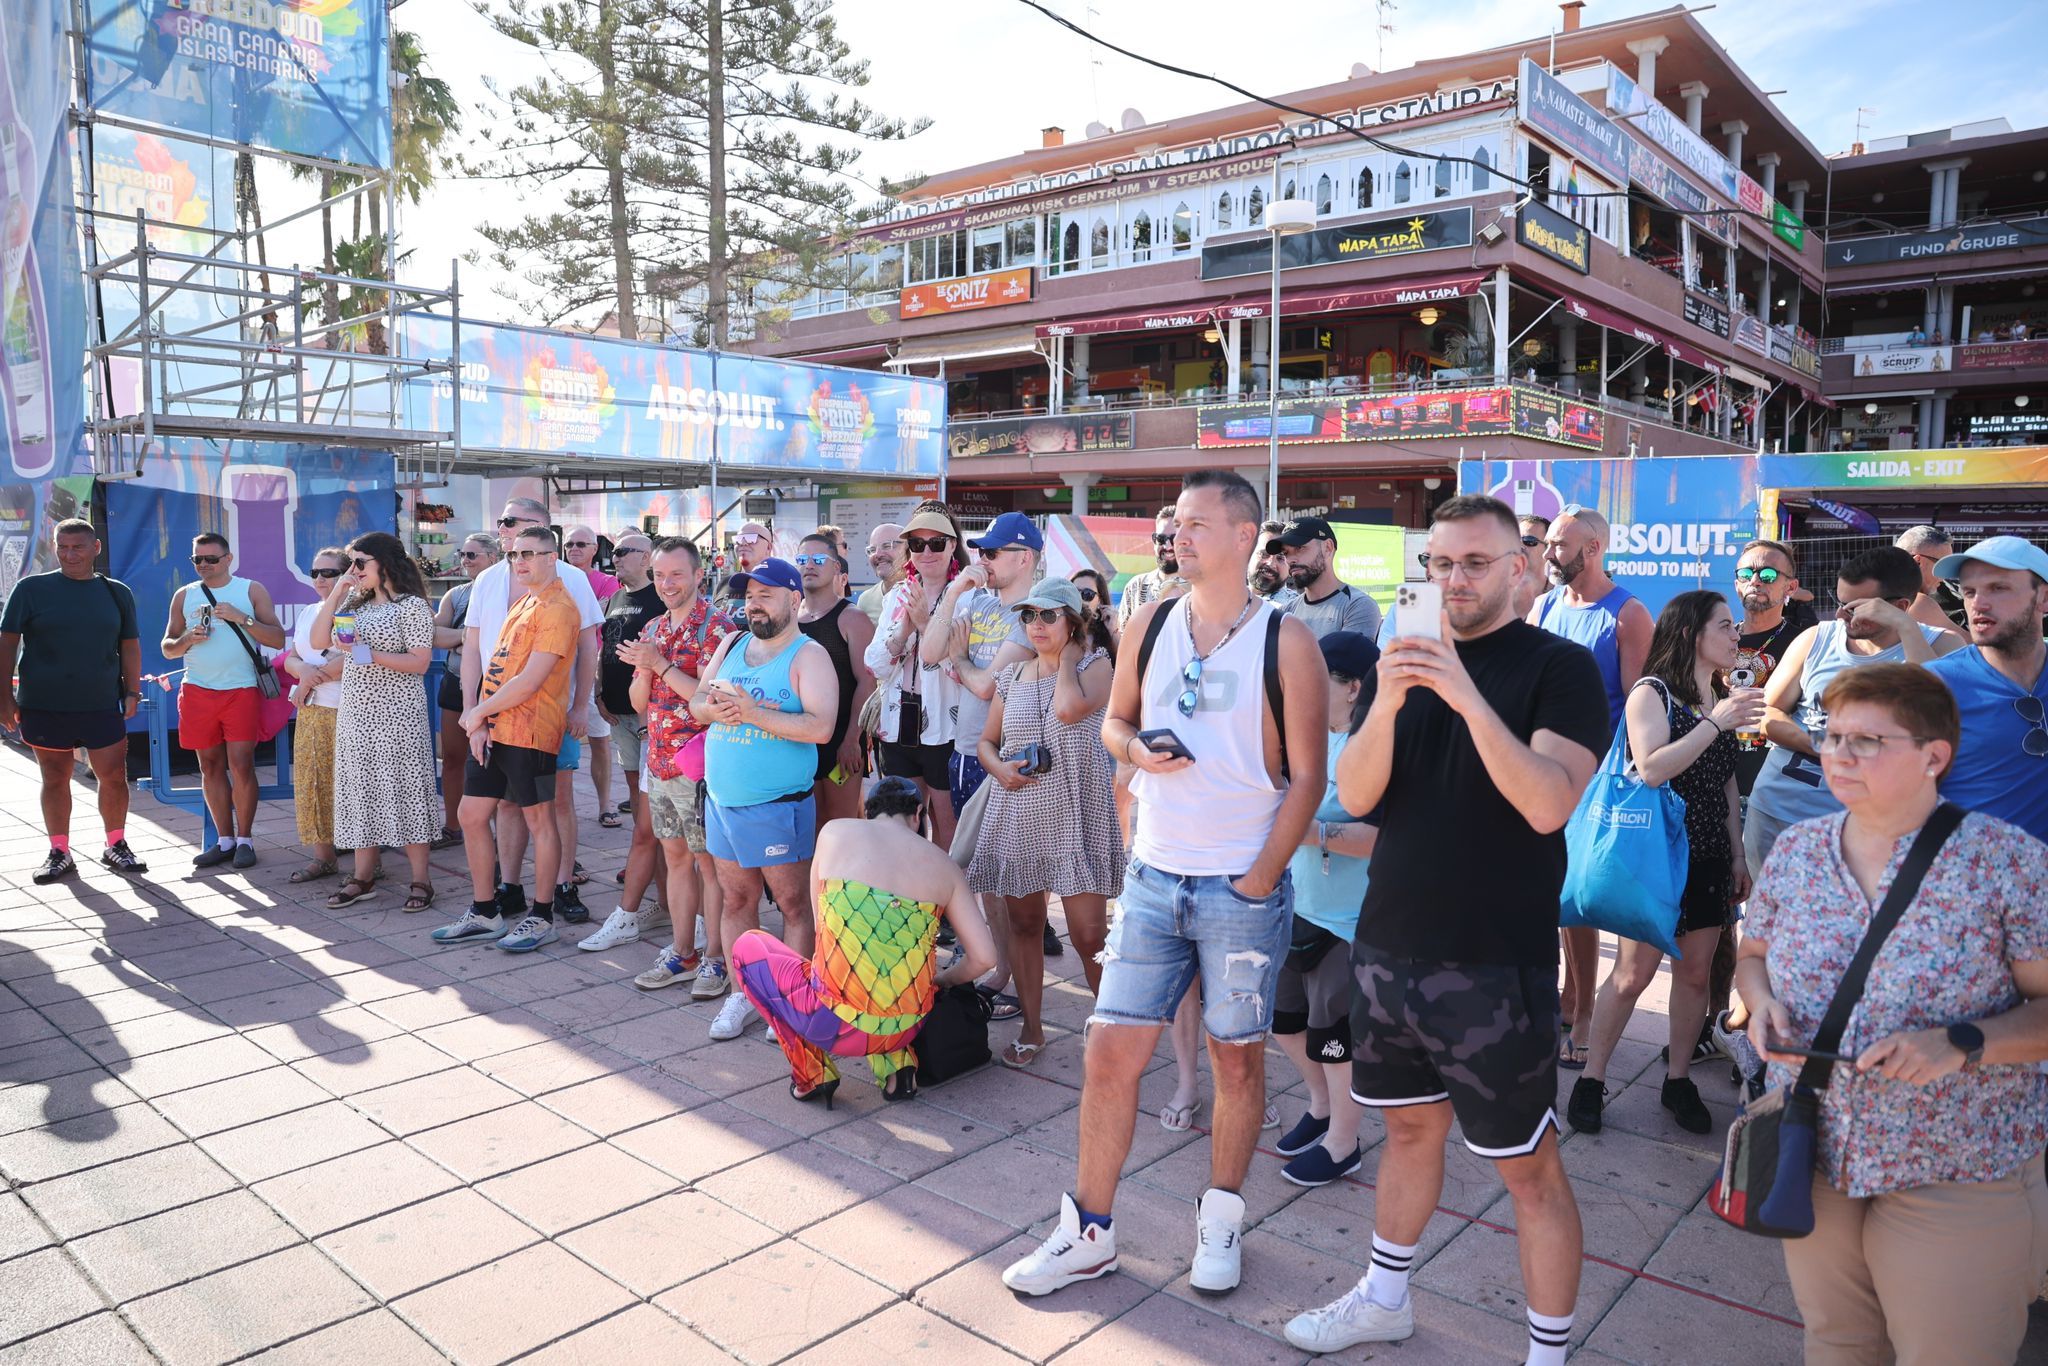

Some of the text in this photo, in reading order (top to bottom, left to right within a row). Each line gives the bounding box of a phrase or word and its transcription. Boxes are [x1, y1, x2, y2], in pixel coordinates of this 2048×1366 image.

[176, 15, 318, 67] GRAN CANARIA
[177, 37, 229, 64] ISLAS
[234, 49, 318, 84] CANARIAS
[1547, 88, 1614, 147] NAMASTE BHARAT
[1657, 108, 1710, 173] Skansen
[889, 221, 946, 240] Skansen
[964, 197, 1065, 227] SKANDINAVISK
[1069, 182, 1141, 206] CENTRUM
[1167, 168, 1222, 188] STEAK
[1226, 156, 1276, 175] HOUS
[1339, 237, 1378, 254] WAPA
[1380, 231, 1419, 247] TAPA
[1900, 233, 2019, 258] FUND GRUBE
[945, 278, 990, 303] SPRITZ
[1396, 286, 1459, 303] WAPA TAPA
[1145, 318, 1169, 328] WAPA
[1169, 316, 1194, 326] TAPA
[1883, 357, 1921, 367] SCRUFF
[645, 384, 785, 432] ABSOLUT.
[819, 407, 862, 428] PRIDE
[896, 408, 931, 424] PROUD
[820, 431, 863, 444] FREEDOM
[897, 423, 929, 440] TO MIX
[951, 429, 1020, 457] Casino
[1847, 461, 1911, 478] SALIDA
[1924, 459, 1967, 476] EXIT
[1279, 505, 1328, 521] Winners
[1605, 523, 1737, 556] BSOLUT.
[1608, 561, 1711, 577] PROUD TO MIX
